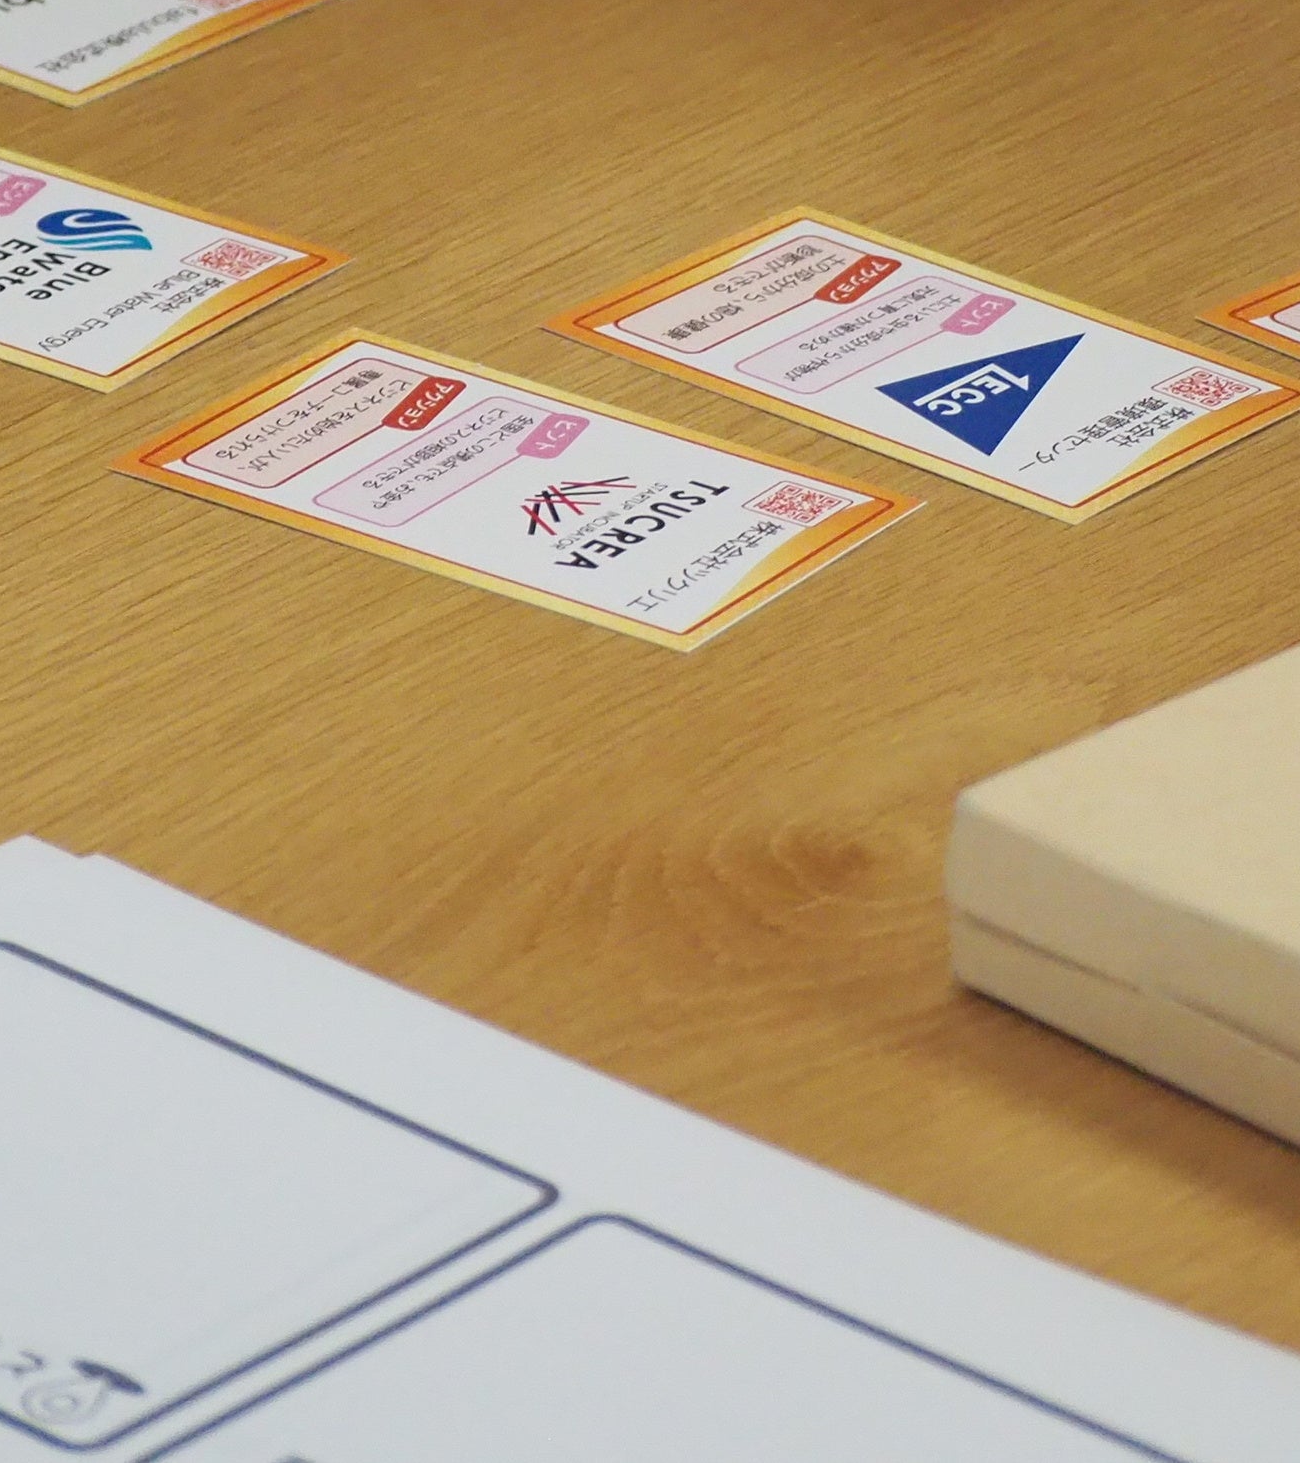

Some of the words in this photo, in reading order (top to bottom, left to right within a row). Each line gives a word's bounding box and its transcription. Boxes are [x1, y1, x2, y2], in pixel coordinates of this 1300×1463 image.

[26, 261, 111, 300] Blue
[153, 269, 201, 290] Blue
[713, 245, 823, 294] 診断ができる
[830, 261, 890, 300] アクション
[104, 291, 161, 319] Water
[151, 277, 225, 312] 株式会社
[667, 254, 845, 341] 土の成分から、畑の健康
[961, 300, 1003, 327] ヒント
[38, 318, 109, 352] Energy
[785, 294, 961, 382] 土にいる虫や成分から作物が
[799, 285, 939, 351] 元気に育つか確かめる
[215, 370, 383, 460] 専属コーチをつけられる
[238, 379, 412, 472] ビジネスを始めたい人が、
[398, 383, 454, 427] アクション
[1106, 407, 1194, 447] 株式会社
[362, 408, 507, 489] ビジネスの相談ができる
[536, 420, 577, 450] ヒント
[1019, 396, 1168, 471] 環境管理センター
[373, 415, 534, 509] 全国どこの拠点でも、お金や
[623, 482, 668, 510] STARTUP
[553, 511, 620, 550] INCUBATOR
[555, 481, 729, 569] TSUCREA
[627, 521, 783, 611] 株式会社ツクリエ
